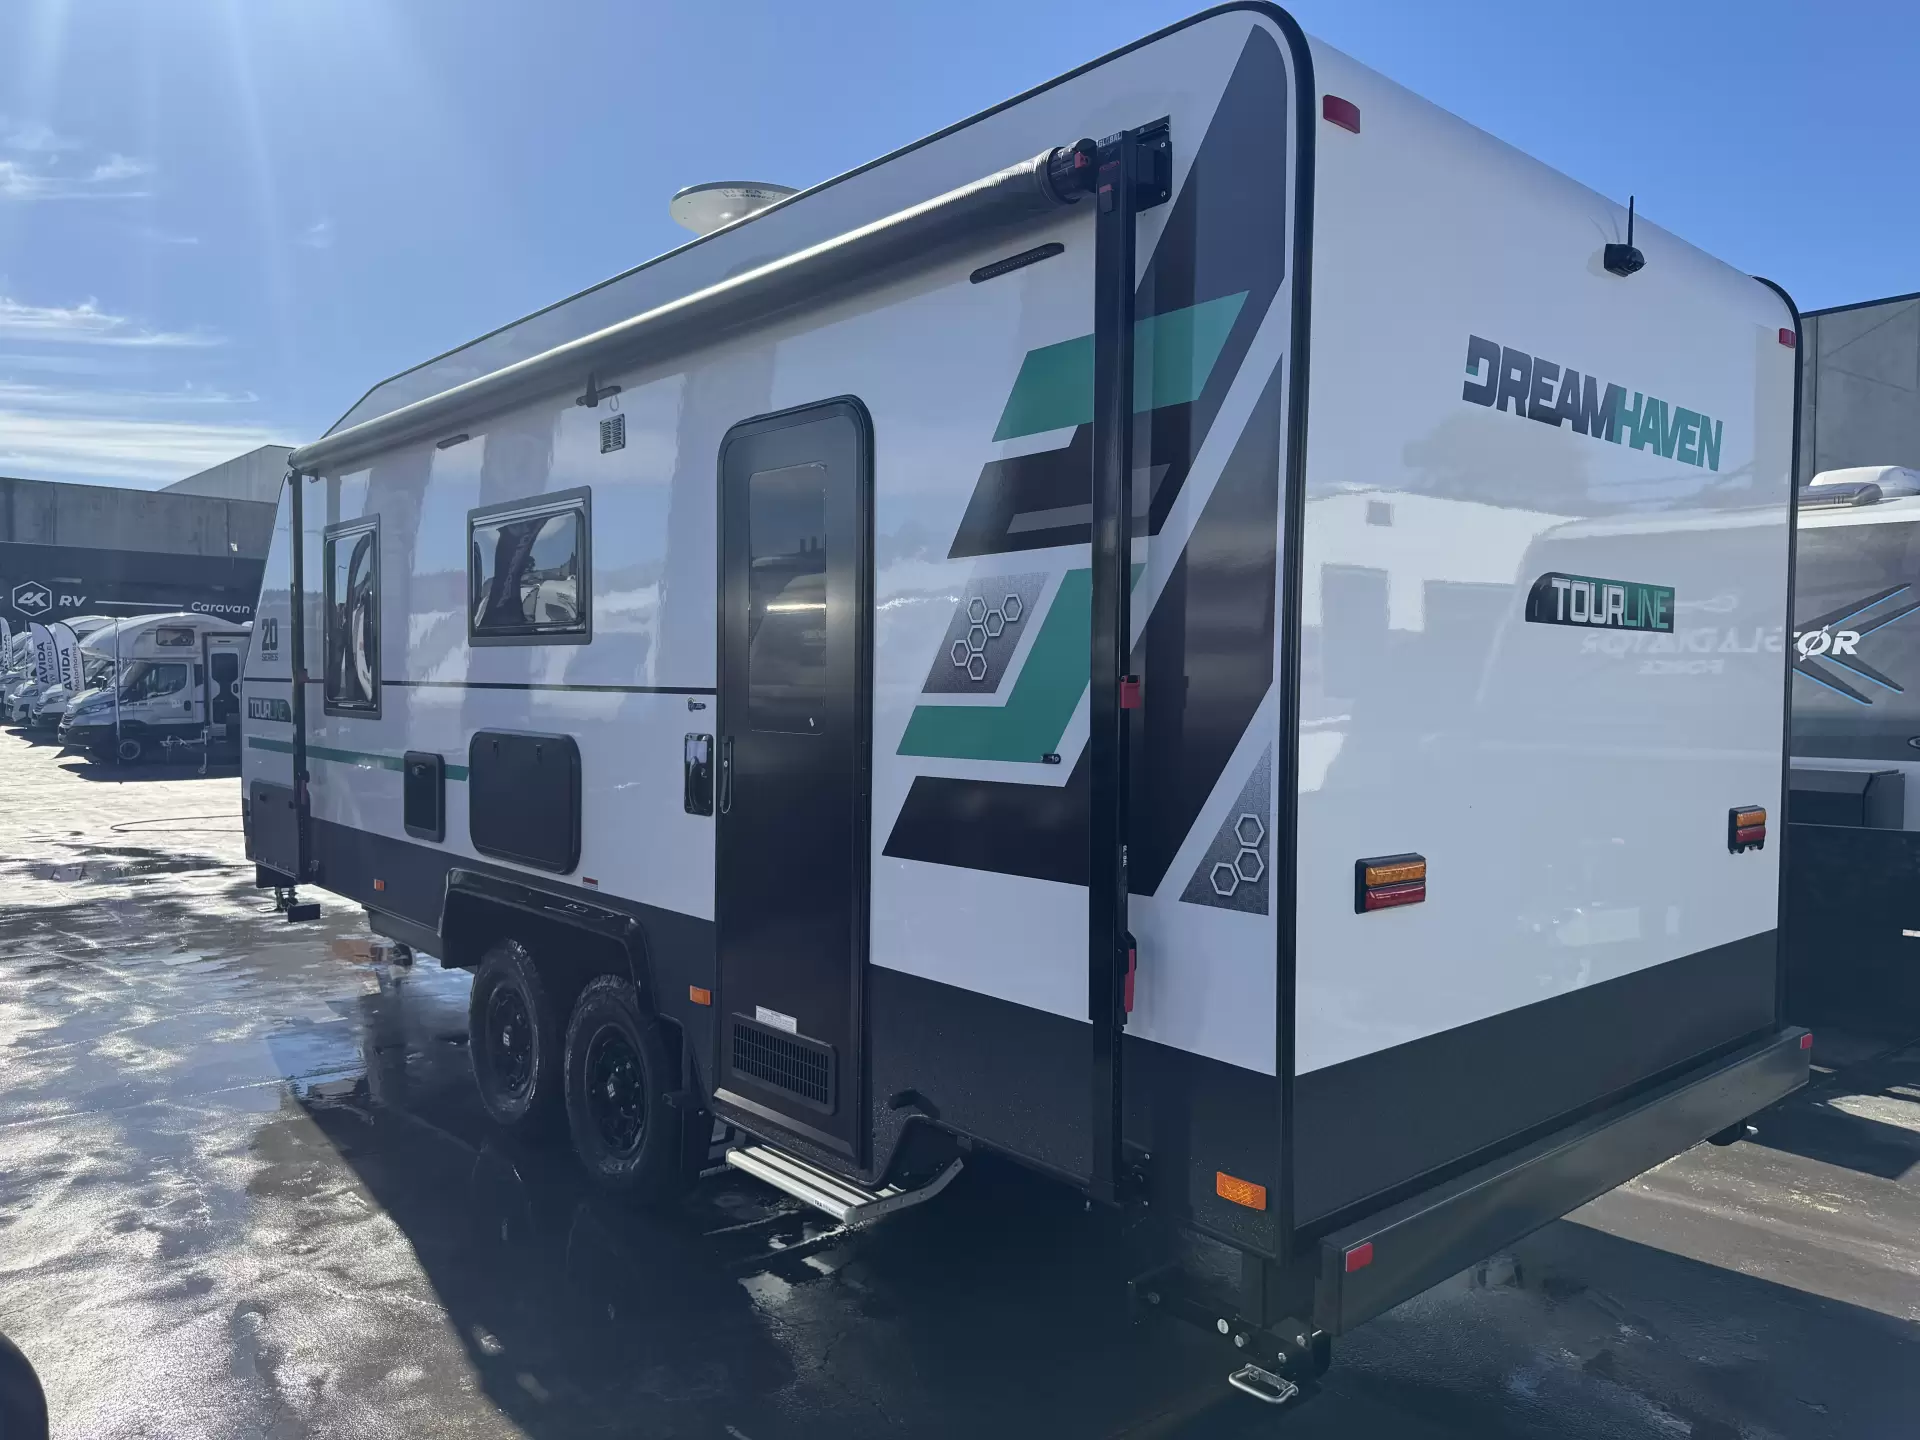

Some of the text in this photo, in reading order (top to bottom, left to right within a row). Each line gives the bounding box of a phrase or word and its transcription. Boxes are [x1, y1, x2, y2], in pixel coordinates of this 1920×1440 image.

[1462, 334, 1723, 472] DREAMHAVEN
[59, 595, 87, 607] RV
[191, 601, 250, 614] Caravan
[1552, 577, 1669, 629] TOURLINE
[262, 618, 278, 651] 20
[37, 642, 48, 684] AVIDA
[61, 648, 73, 691] AVIDA
[261, 653, 279, 661] SERIES
